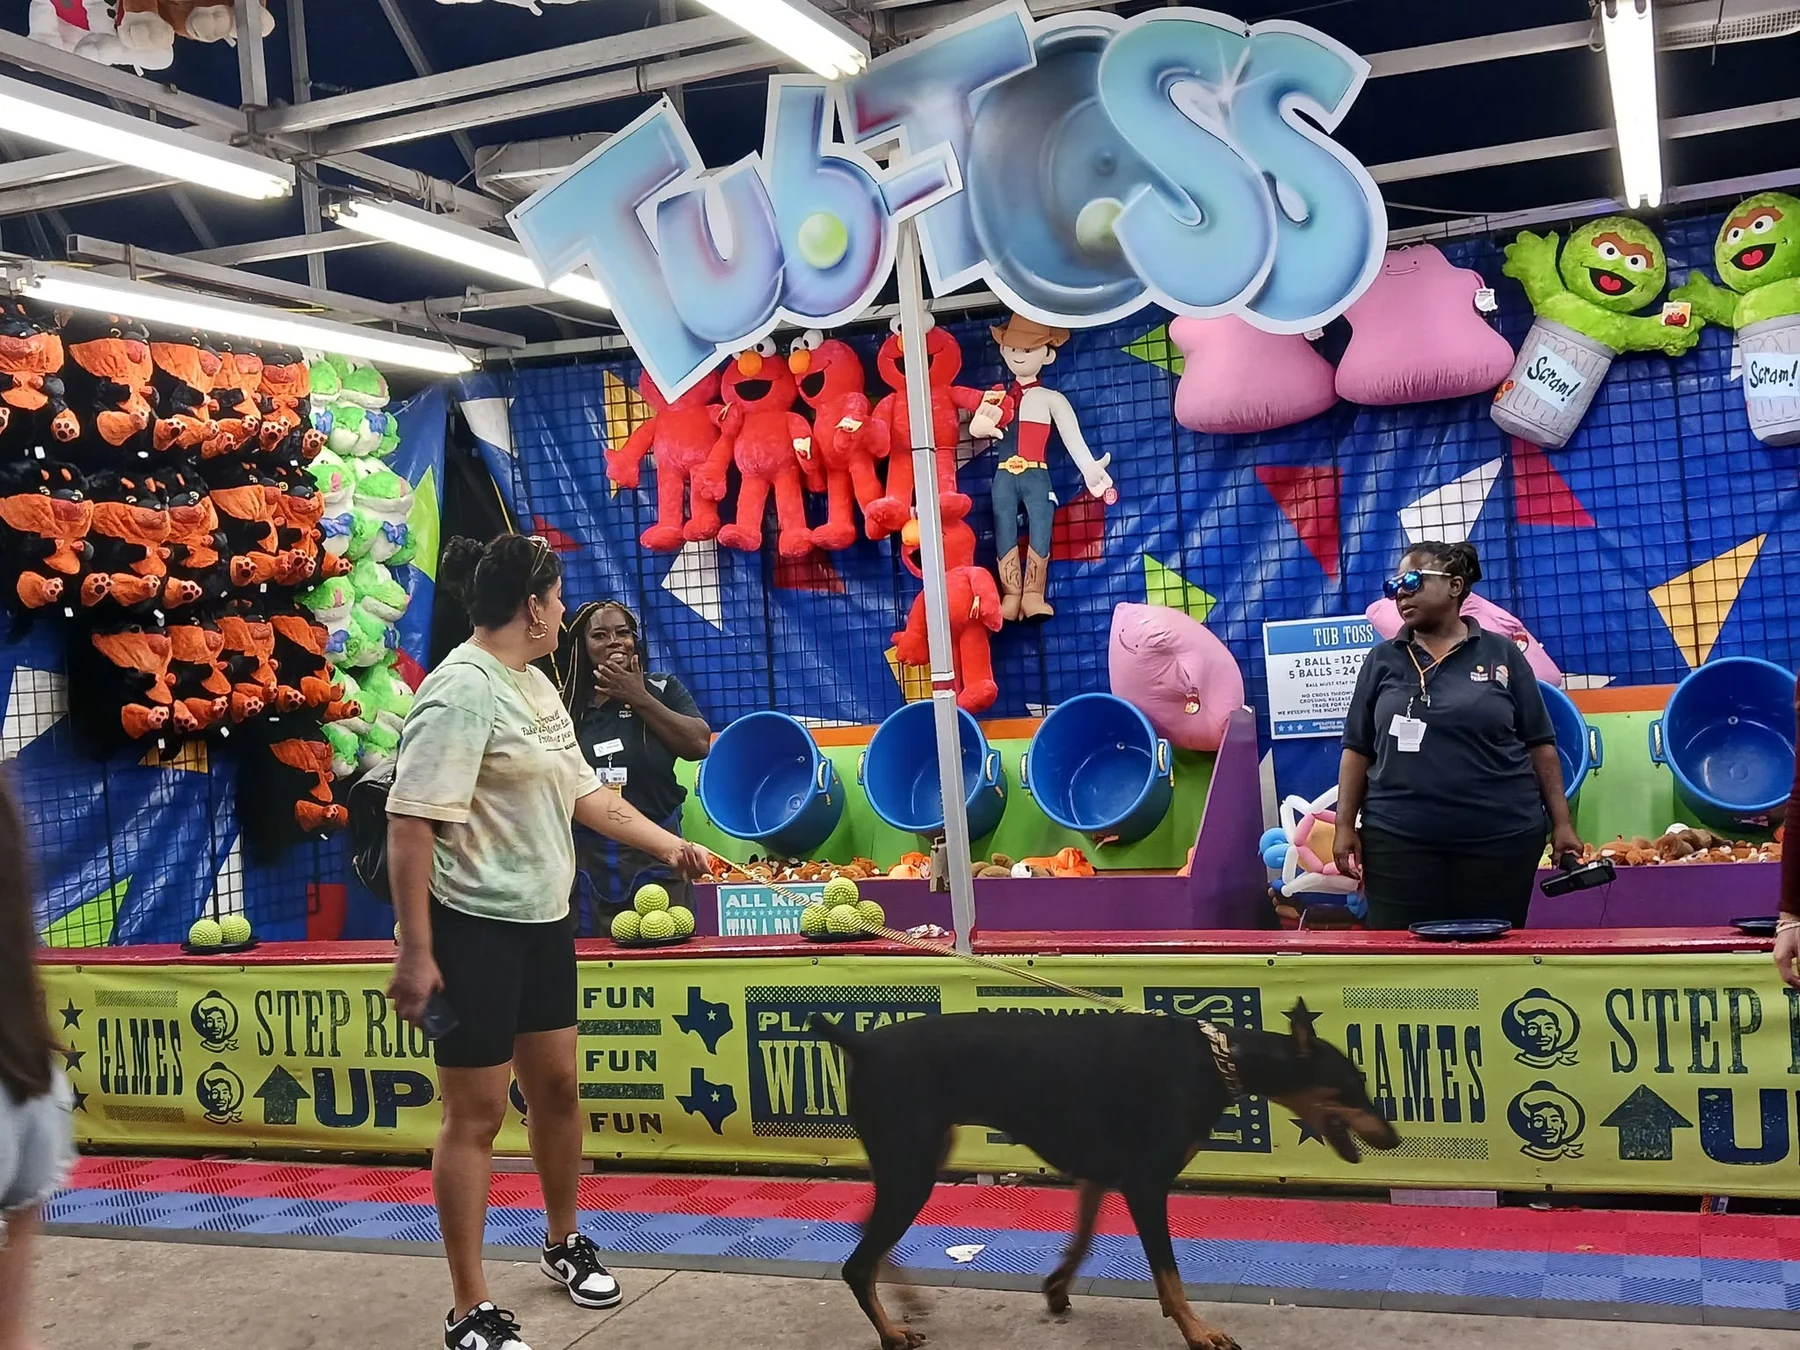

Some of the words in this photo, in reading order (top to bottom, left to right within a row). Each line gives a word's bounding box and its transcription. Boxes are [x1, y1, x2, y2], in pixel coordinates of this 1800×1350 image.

[1527, 356, 1581, 402] Scram!
[1749, 359, 1799, 389] Scram!
[1313, 627, 1339, 646] TUB
[1343, 624, 1373, 644] TOSS
[1289, 670, 1295, 679] 5
[1299, 667, 1332, 678] BALLS
[1343, 666, 1356, 676] 24
[1295, 659, 1301, 668] 2
[1304, 656, 1331, 666] BALL
[726, 893, 767, 908] ALL
[583, 986, 655, 1009] FUN
[255, 989, 351, 1060] STEP
[1605, 987, 1762, 1074] STEP
[97, 1017, 184, 1096] GAMES
[585, 1049, 657, 1072] FUN
[758, 1040, 849, 1116] WIN
[313, 1067, 434, 1128] UP
[590, 1112, 662, 1134] FUN
